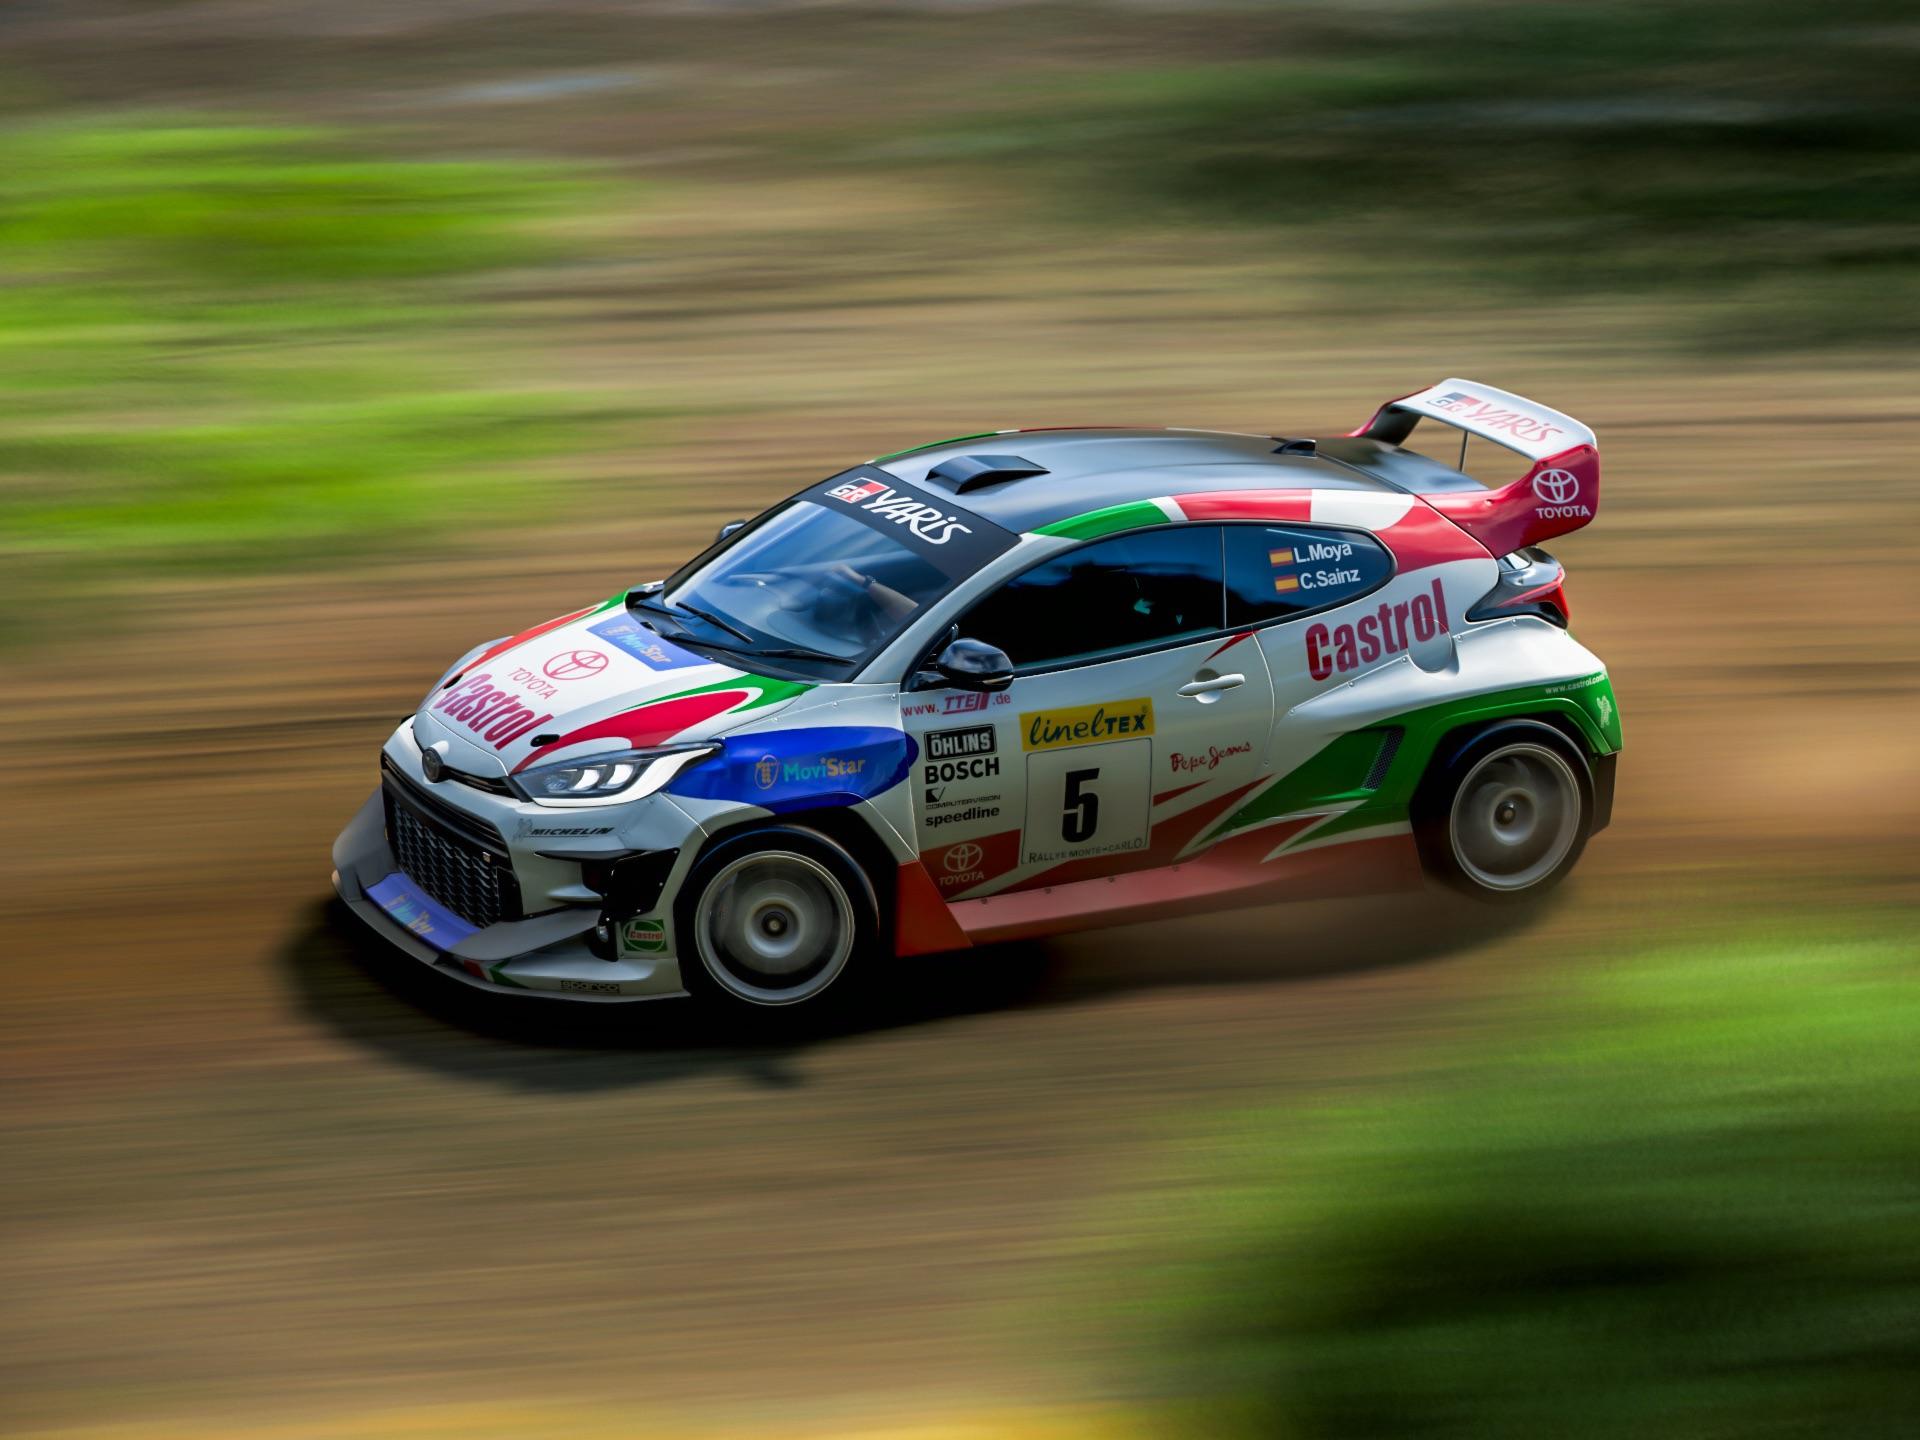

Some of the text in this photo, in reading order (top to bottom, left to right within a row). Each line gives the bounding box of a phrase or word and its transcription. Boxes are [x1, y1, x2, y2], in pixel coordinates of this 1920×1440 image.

[828, 481, 876, 503] GR
[1536, 505, 1591, 520] TOYOTA
[1293, 543, 1352, 563] L.Moya
[1300, 568, 1361, 590] C.Sainz
[1305, 577, 1450, 681] Castrol
[508, 667, 559, 700] TOYOTA
[433, 673, 554, 751] Castrol
[930, 732, 992, 757] ÖHLINS
[925, 757, 1000, 785] BOSCH
[1170, 752, 1207, 773] Pepe
[1061, 767, 1100, 843] 5
[925, 806, 1000, 828] speedline
[530, 827, 615, 836] MICHELIN
[1029, 850, 1067, 864] RALLYE
[939, 871, 985, 887] TOYOTA
[630, 930, 663, 940] Castrol
